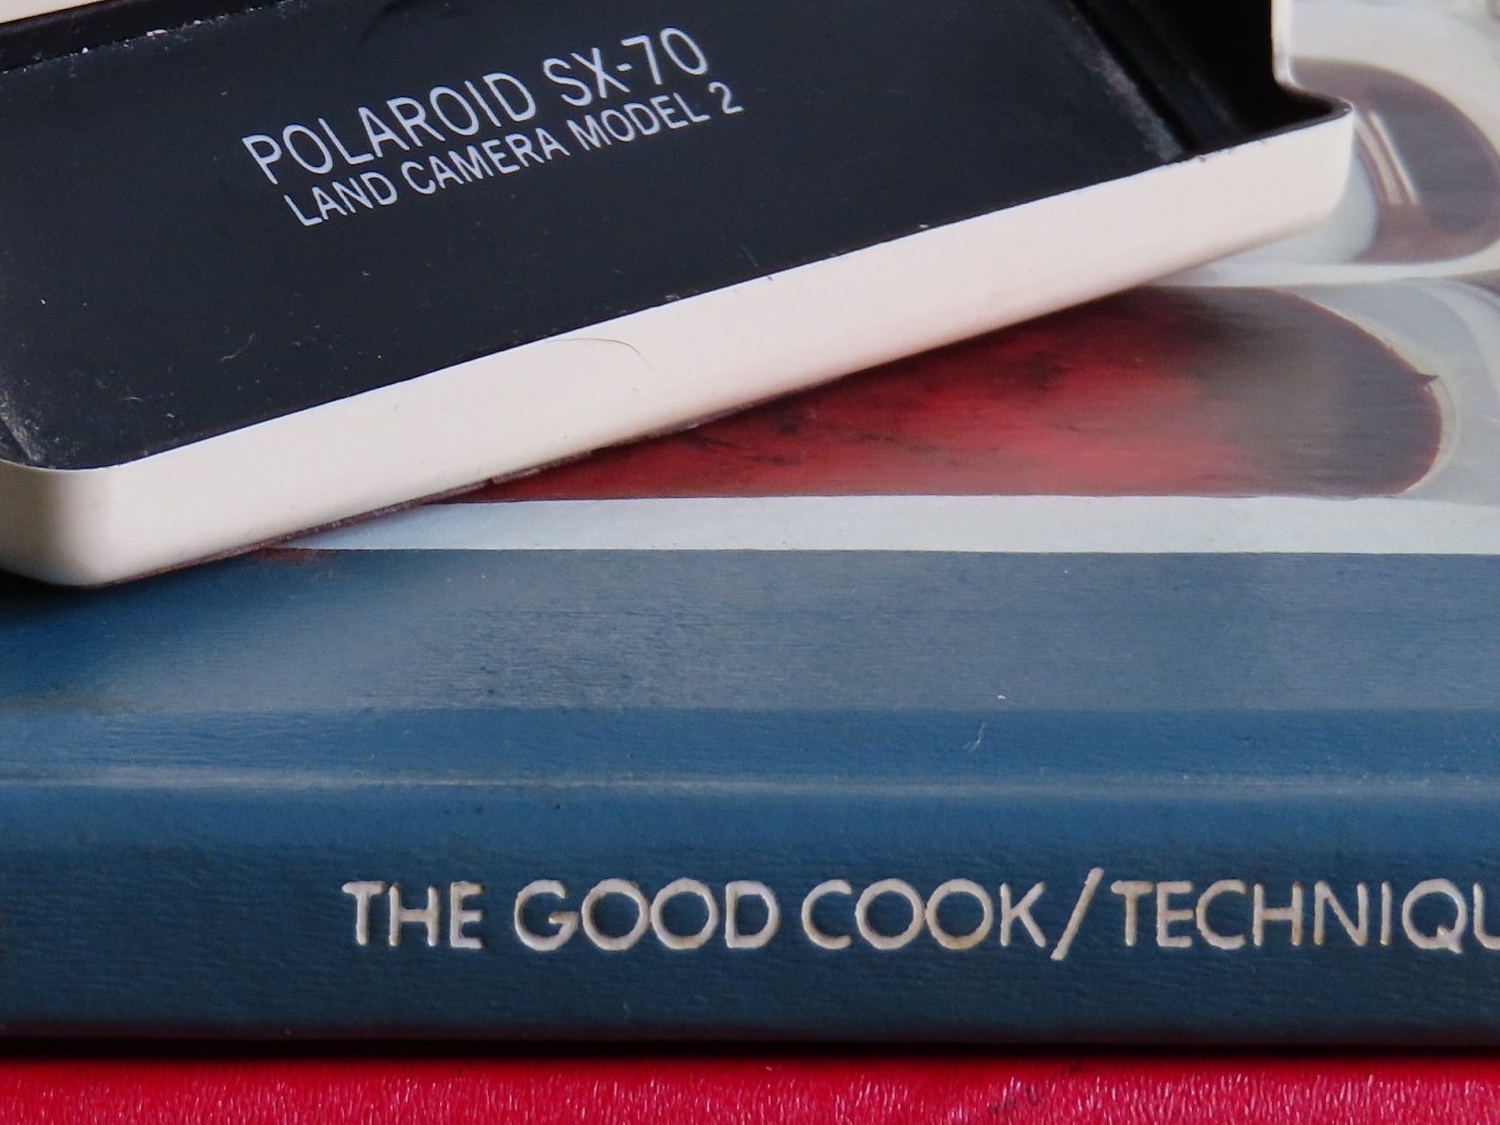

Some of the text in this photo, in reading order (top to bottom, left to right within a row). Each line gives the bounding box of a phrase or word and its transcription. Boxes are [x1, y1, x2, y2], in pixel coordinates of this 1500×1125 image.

[241, 27, 709, 185] POLAROID SX-70
[283, 81, 744, 227] LAND CAMERA MODEL 2
[341, 880, 483, 949] THE
[513, 877, 779, 952] GOOD
